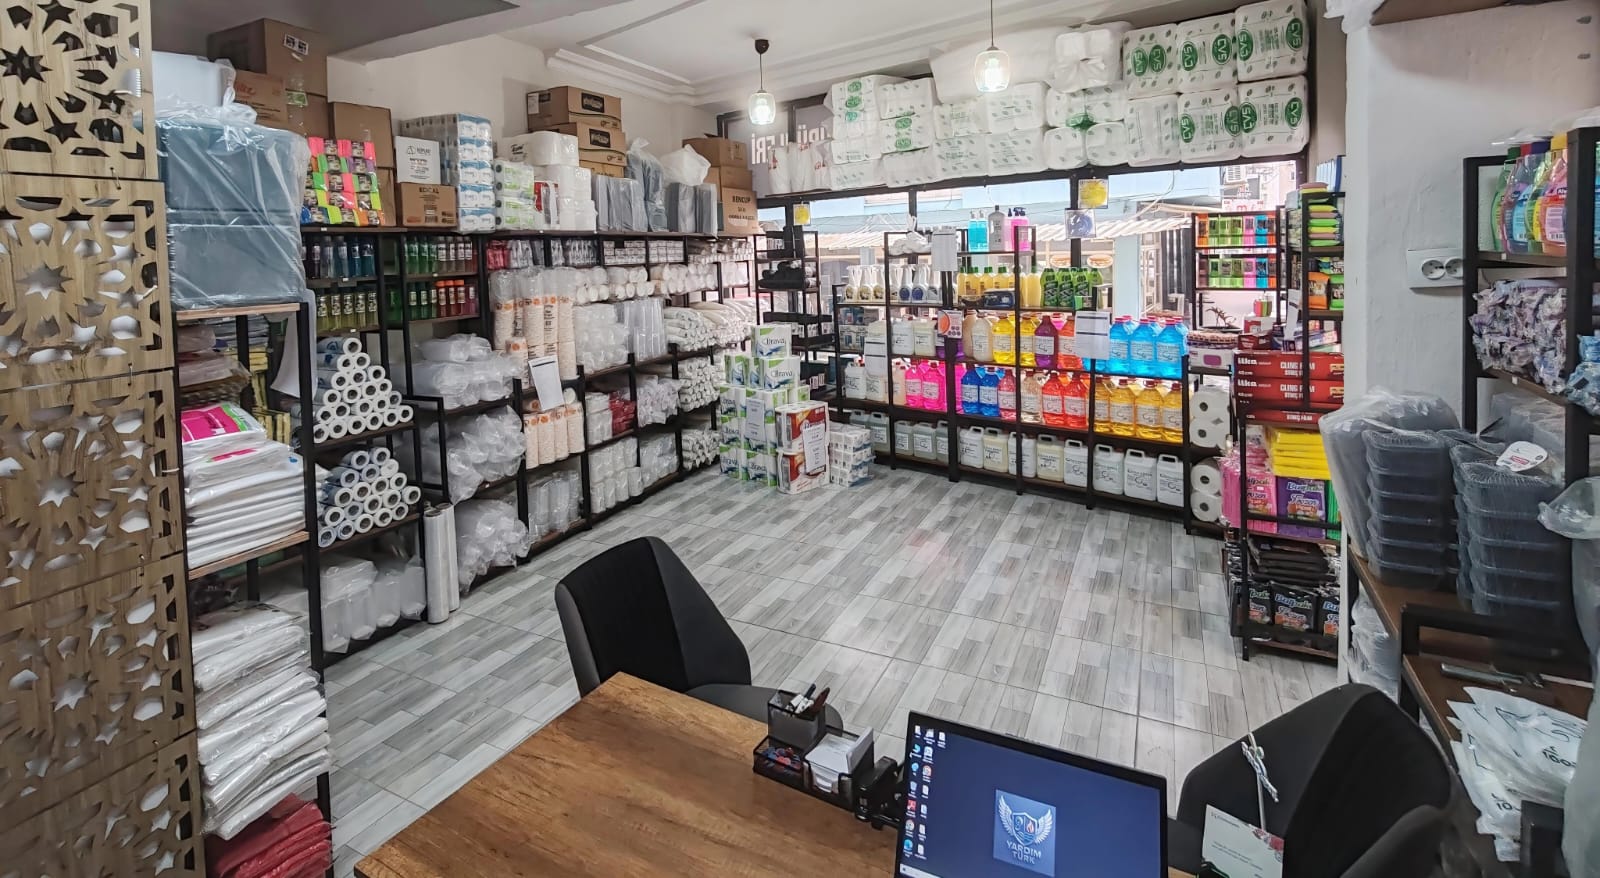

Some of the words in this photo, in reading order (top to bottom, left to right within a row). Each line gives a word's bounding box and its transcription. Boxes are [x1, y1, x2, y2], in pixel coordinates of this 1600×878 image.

[1291, 22, 1300, 46] CVS
[1183, 46, 1193, 68] CVS
[1217, 38, 1227, 60] CVS
[1240, 34, 1248, 58] CVS
[1153, 48, 1161, 72] CVS
[1242, 107, 1252, 130] CVS
[1291, 102, 1299, 124] CVS
[1181, 117, 1191, 140] CVS
[1006, 840, 1042, 858] YARDIM
